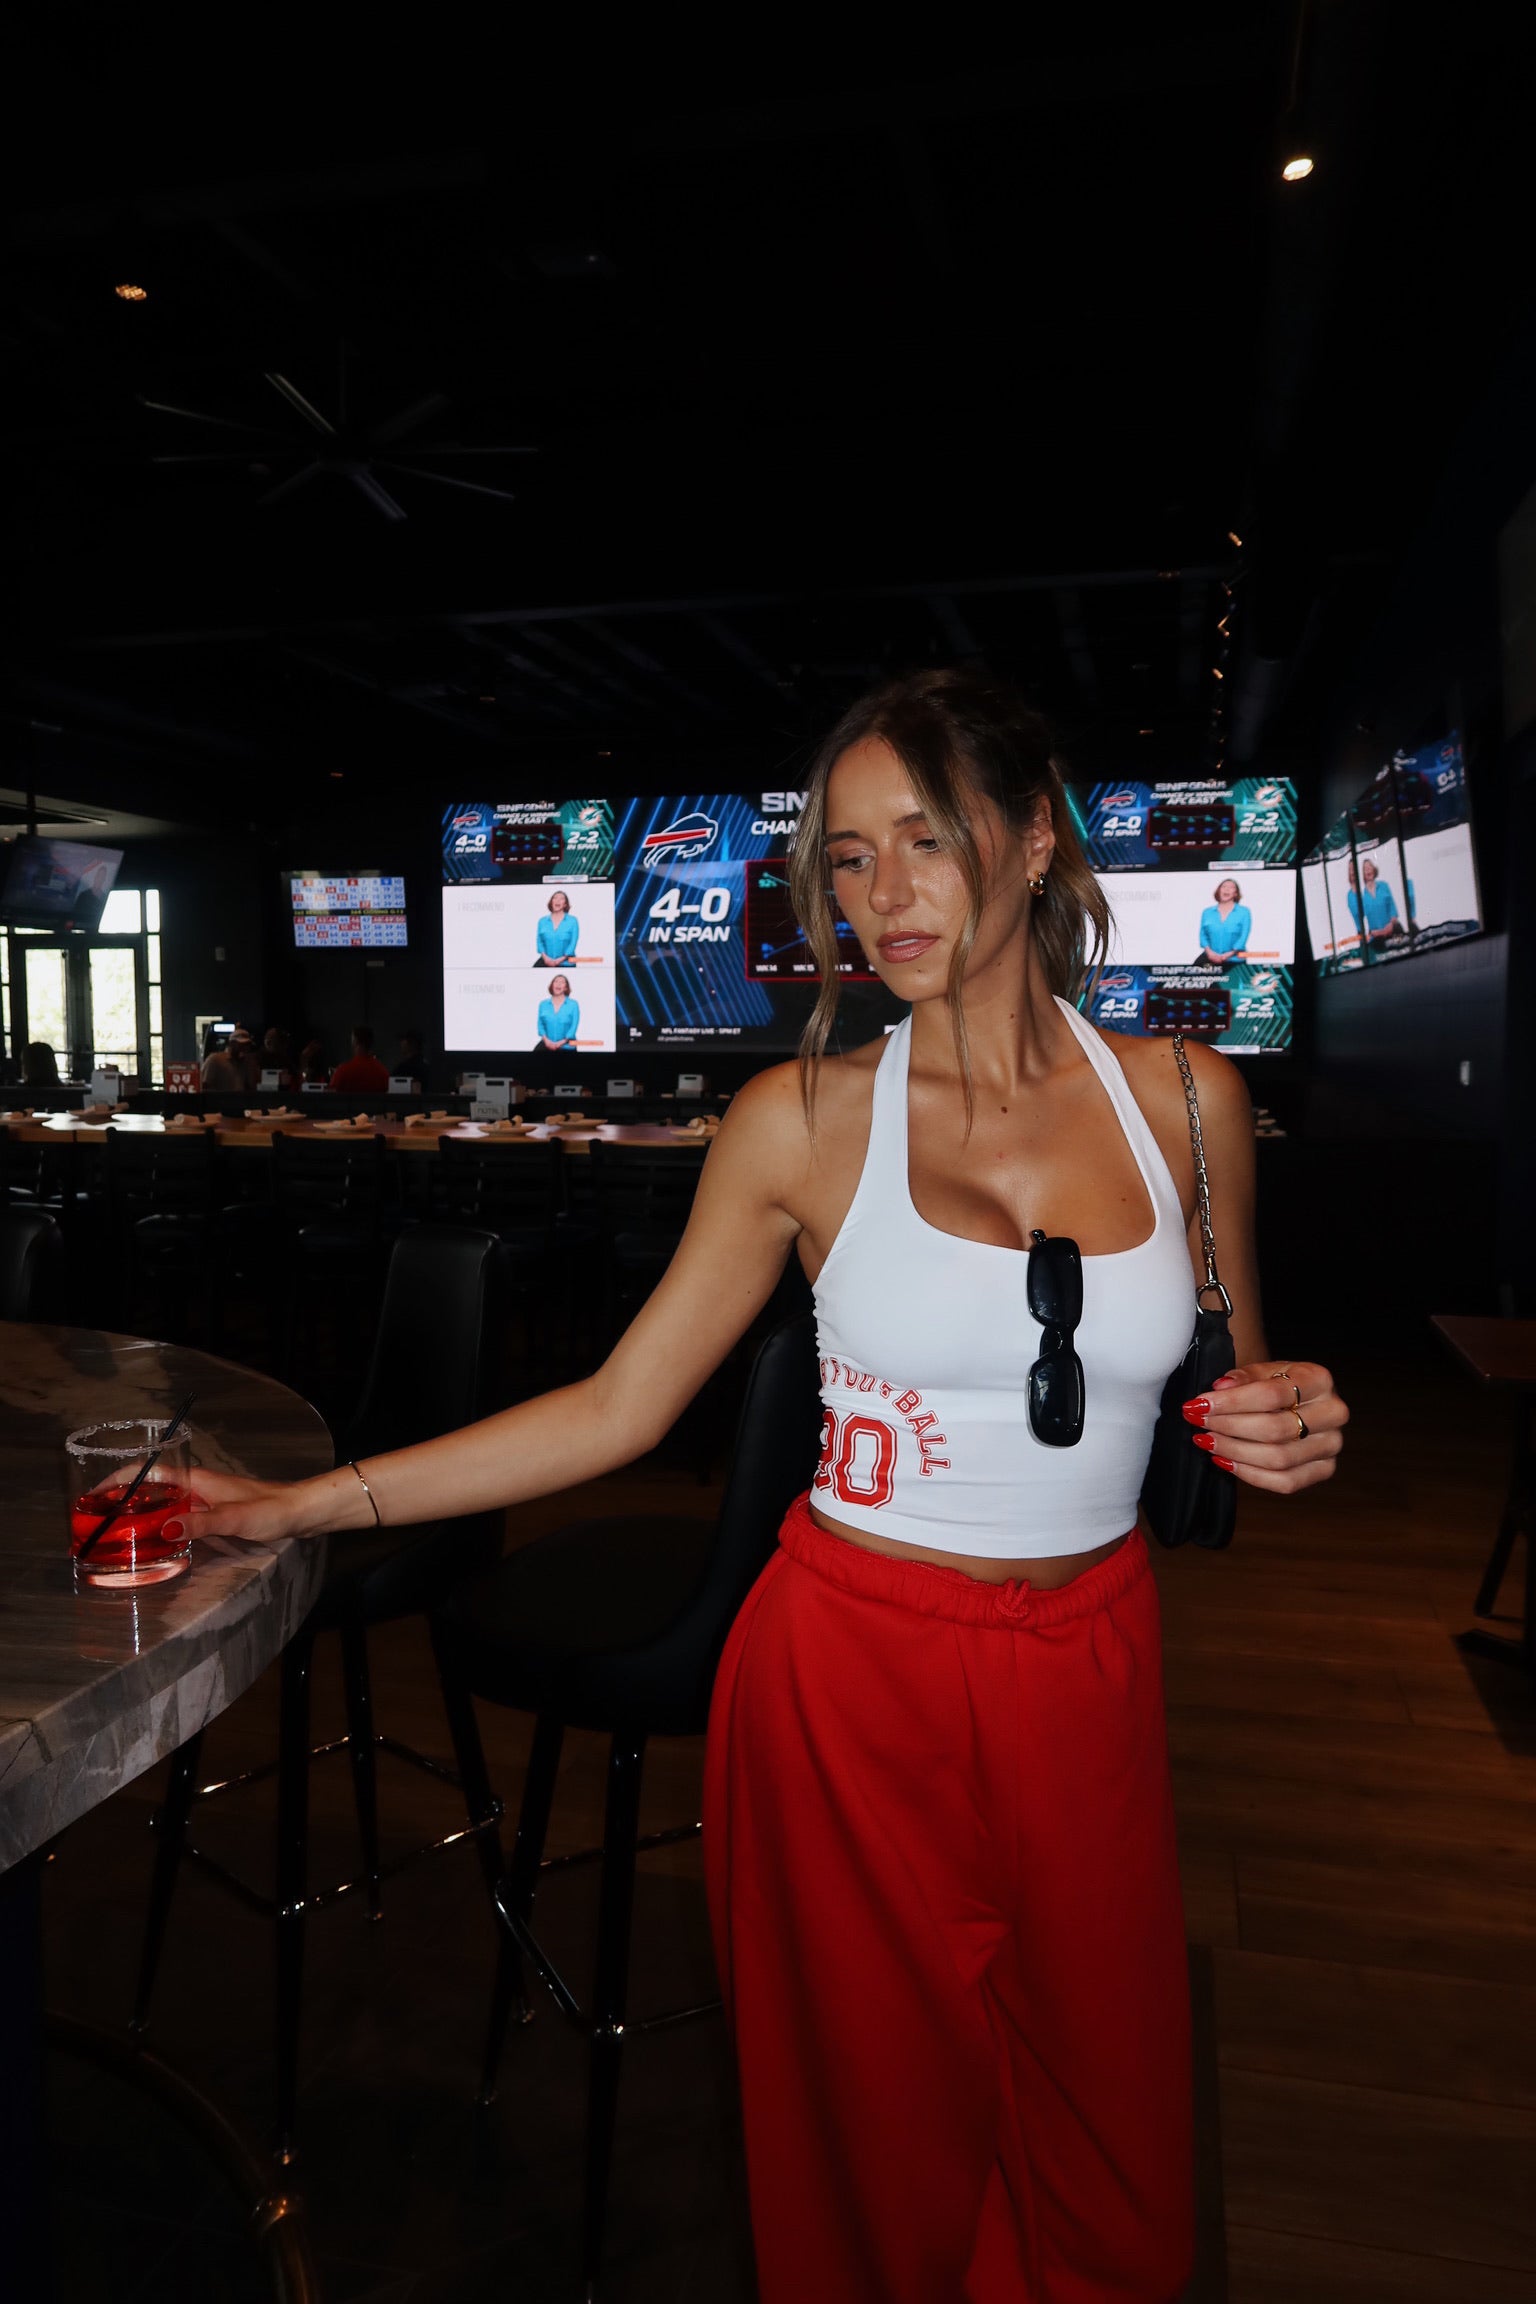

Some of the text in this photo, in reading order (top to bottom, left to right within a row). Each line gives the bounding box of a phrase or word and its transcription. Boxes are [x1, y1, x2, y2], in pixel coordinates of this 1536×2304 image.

[761, 792, 809, 813] SN
[1103, 815, 1142, 830] 4-0
[1240, 812, 1279, 826] 2-2
[751, 820, 798, 836] CHAN
[455, 834, 487, 847] 4-0
[567, 831, 599, 844] 2-2
[649, 887, 730, 923] 4-0
[649, 926, 731, 943] IN SPAN
[1100, 998, 1139, 1012] 4-0
[1236, 998, 1274, 1011] 2-2
